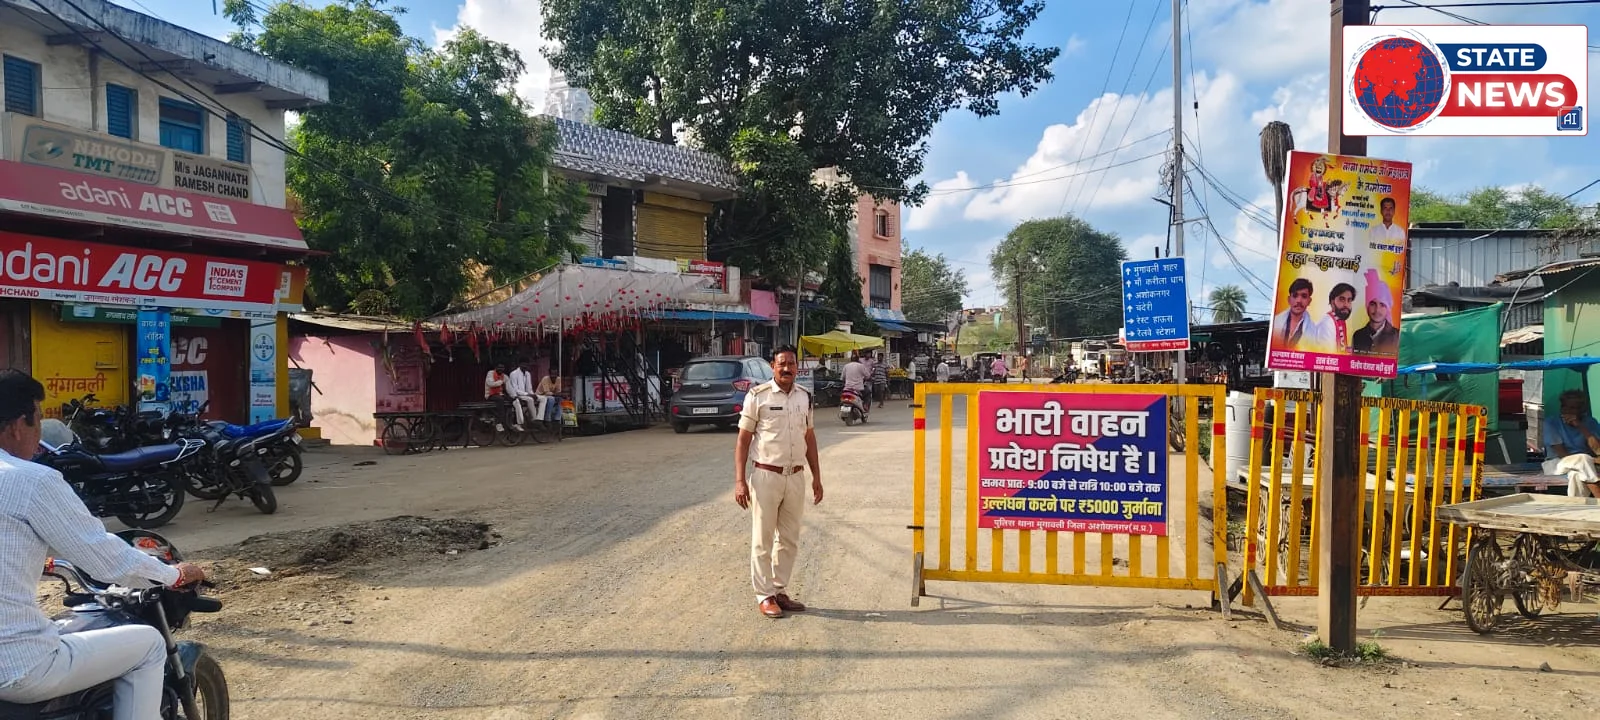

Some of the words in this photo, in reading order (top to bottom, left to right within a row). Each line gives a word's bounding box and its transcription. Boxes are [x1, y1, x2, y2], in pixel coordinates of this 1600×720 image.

[72, 154, 114, 173] TMT
[74, 140, 156, 168] NAKODA
[174, 160, 190, 174] M/s
[193, 164, 248, 186] JAGANNATH
[174, 175, 214, 192] RAMESH
[218, 184, 248, 198] CHAND
[59, 181, 132, 209] adani
[139, 192, 193, 218] ACC
[0, 242, 90, 286] dani
[98, 253, 188, 292] ACC
[210, 266, 244, 278] INDIA'S
[1134, 263, 1159, 277] मुंगावली
[1162, 264, 1178, 272] शहर
[1286, 252, 1308, 269] बहुत
[1335, 254, 1361, 273] बधाई
[1145, 276, 1167, 285] करीला
[1170, 276, 1184, 284] धाम
[1135, 289, 1170, 299] अशोकनगर
[1136, 301, 1153, 311] चंदेरी
[1136, 315, 1149, 324] रेस्ट
[1137, 326, 1152, 336] रेलवे
[1156, 326, 1176, 336] स्टेशन
[46, 372, 108, 398] मुंगावली
[1284, 391, 1309, 402] PUBLIC
[1312, 392, 1323, 404] WO
[1385, 398, 1412, 411] DIVISION
[996, 401, 1064, 436] भारी
[1068, 410, 1149, 437] वाहन
[988, 442, 1046, 471] प्रवेश
[1050, 443, 1119, 473] निषेध
[1122, 444, 1142, 473] है
[981, 478, 1006, 488] समय
[1028, 480, 1049, 489] 9:00
[1051, 478, 1066, 490] बजे
[1068, 478, 1077, 490] से
[1079, 479, 1098, 491] रात्रि
[1100, 482, 1126, 492] 10:00
[1128, 481, 1144, 493] बजे
[1145, 484, 1161, 493] तक
[981, 493, 1027, 511] उल्लंघन
[1028, 494, 1058, 512] करने
[1061, 498, 1076, 512] पर
[1079, 500, 1118, 514] ₹5000
[1120, 498, 1163, 519] जुर्माना
[994, 517, 1015, 528] पुलिस
[1067, 520, 1086, 529] जिला
